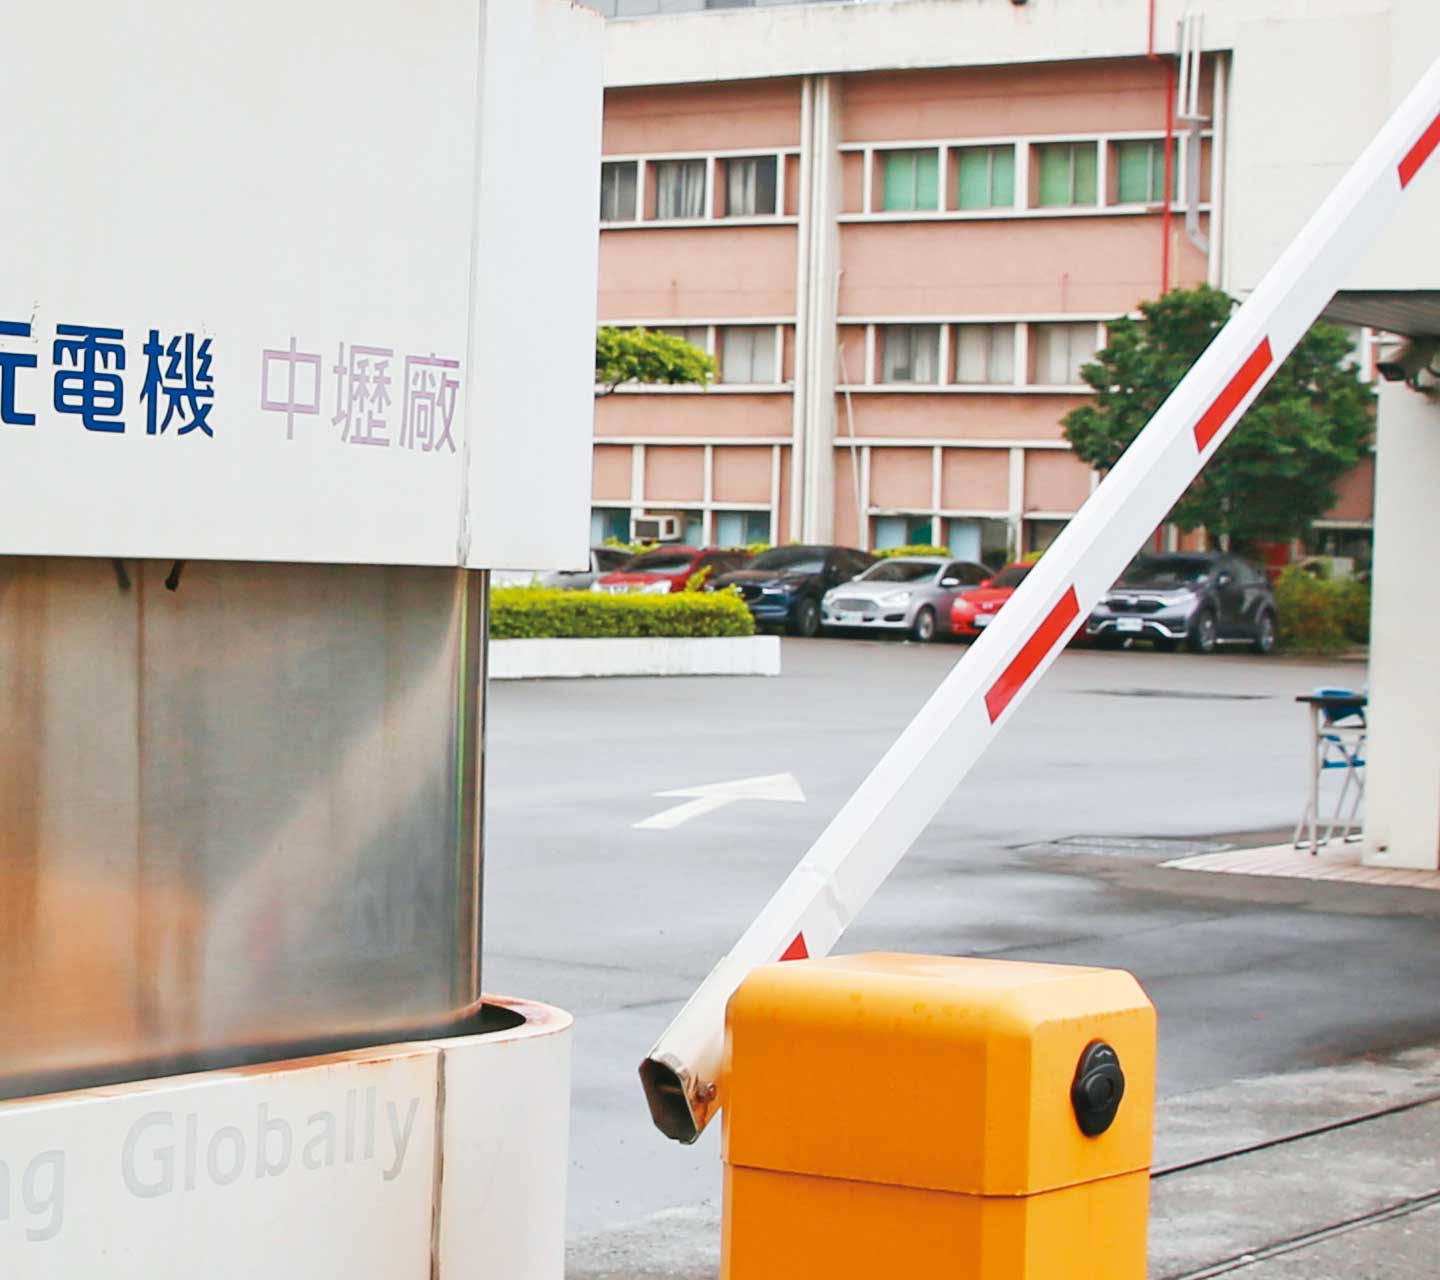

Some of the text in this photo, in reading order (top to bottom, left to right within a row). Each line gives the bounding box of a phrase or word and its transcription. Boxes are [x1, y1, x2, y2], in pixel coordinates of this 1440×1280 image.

[261, 336, 461, 454] 中壢廠
[121, 1086, 422, 1199] Globally
